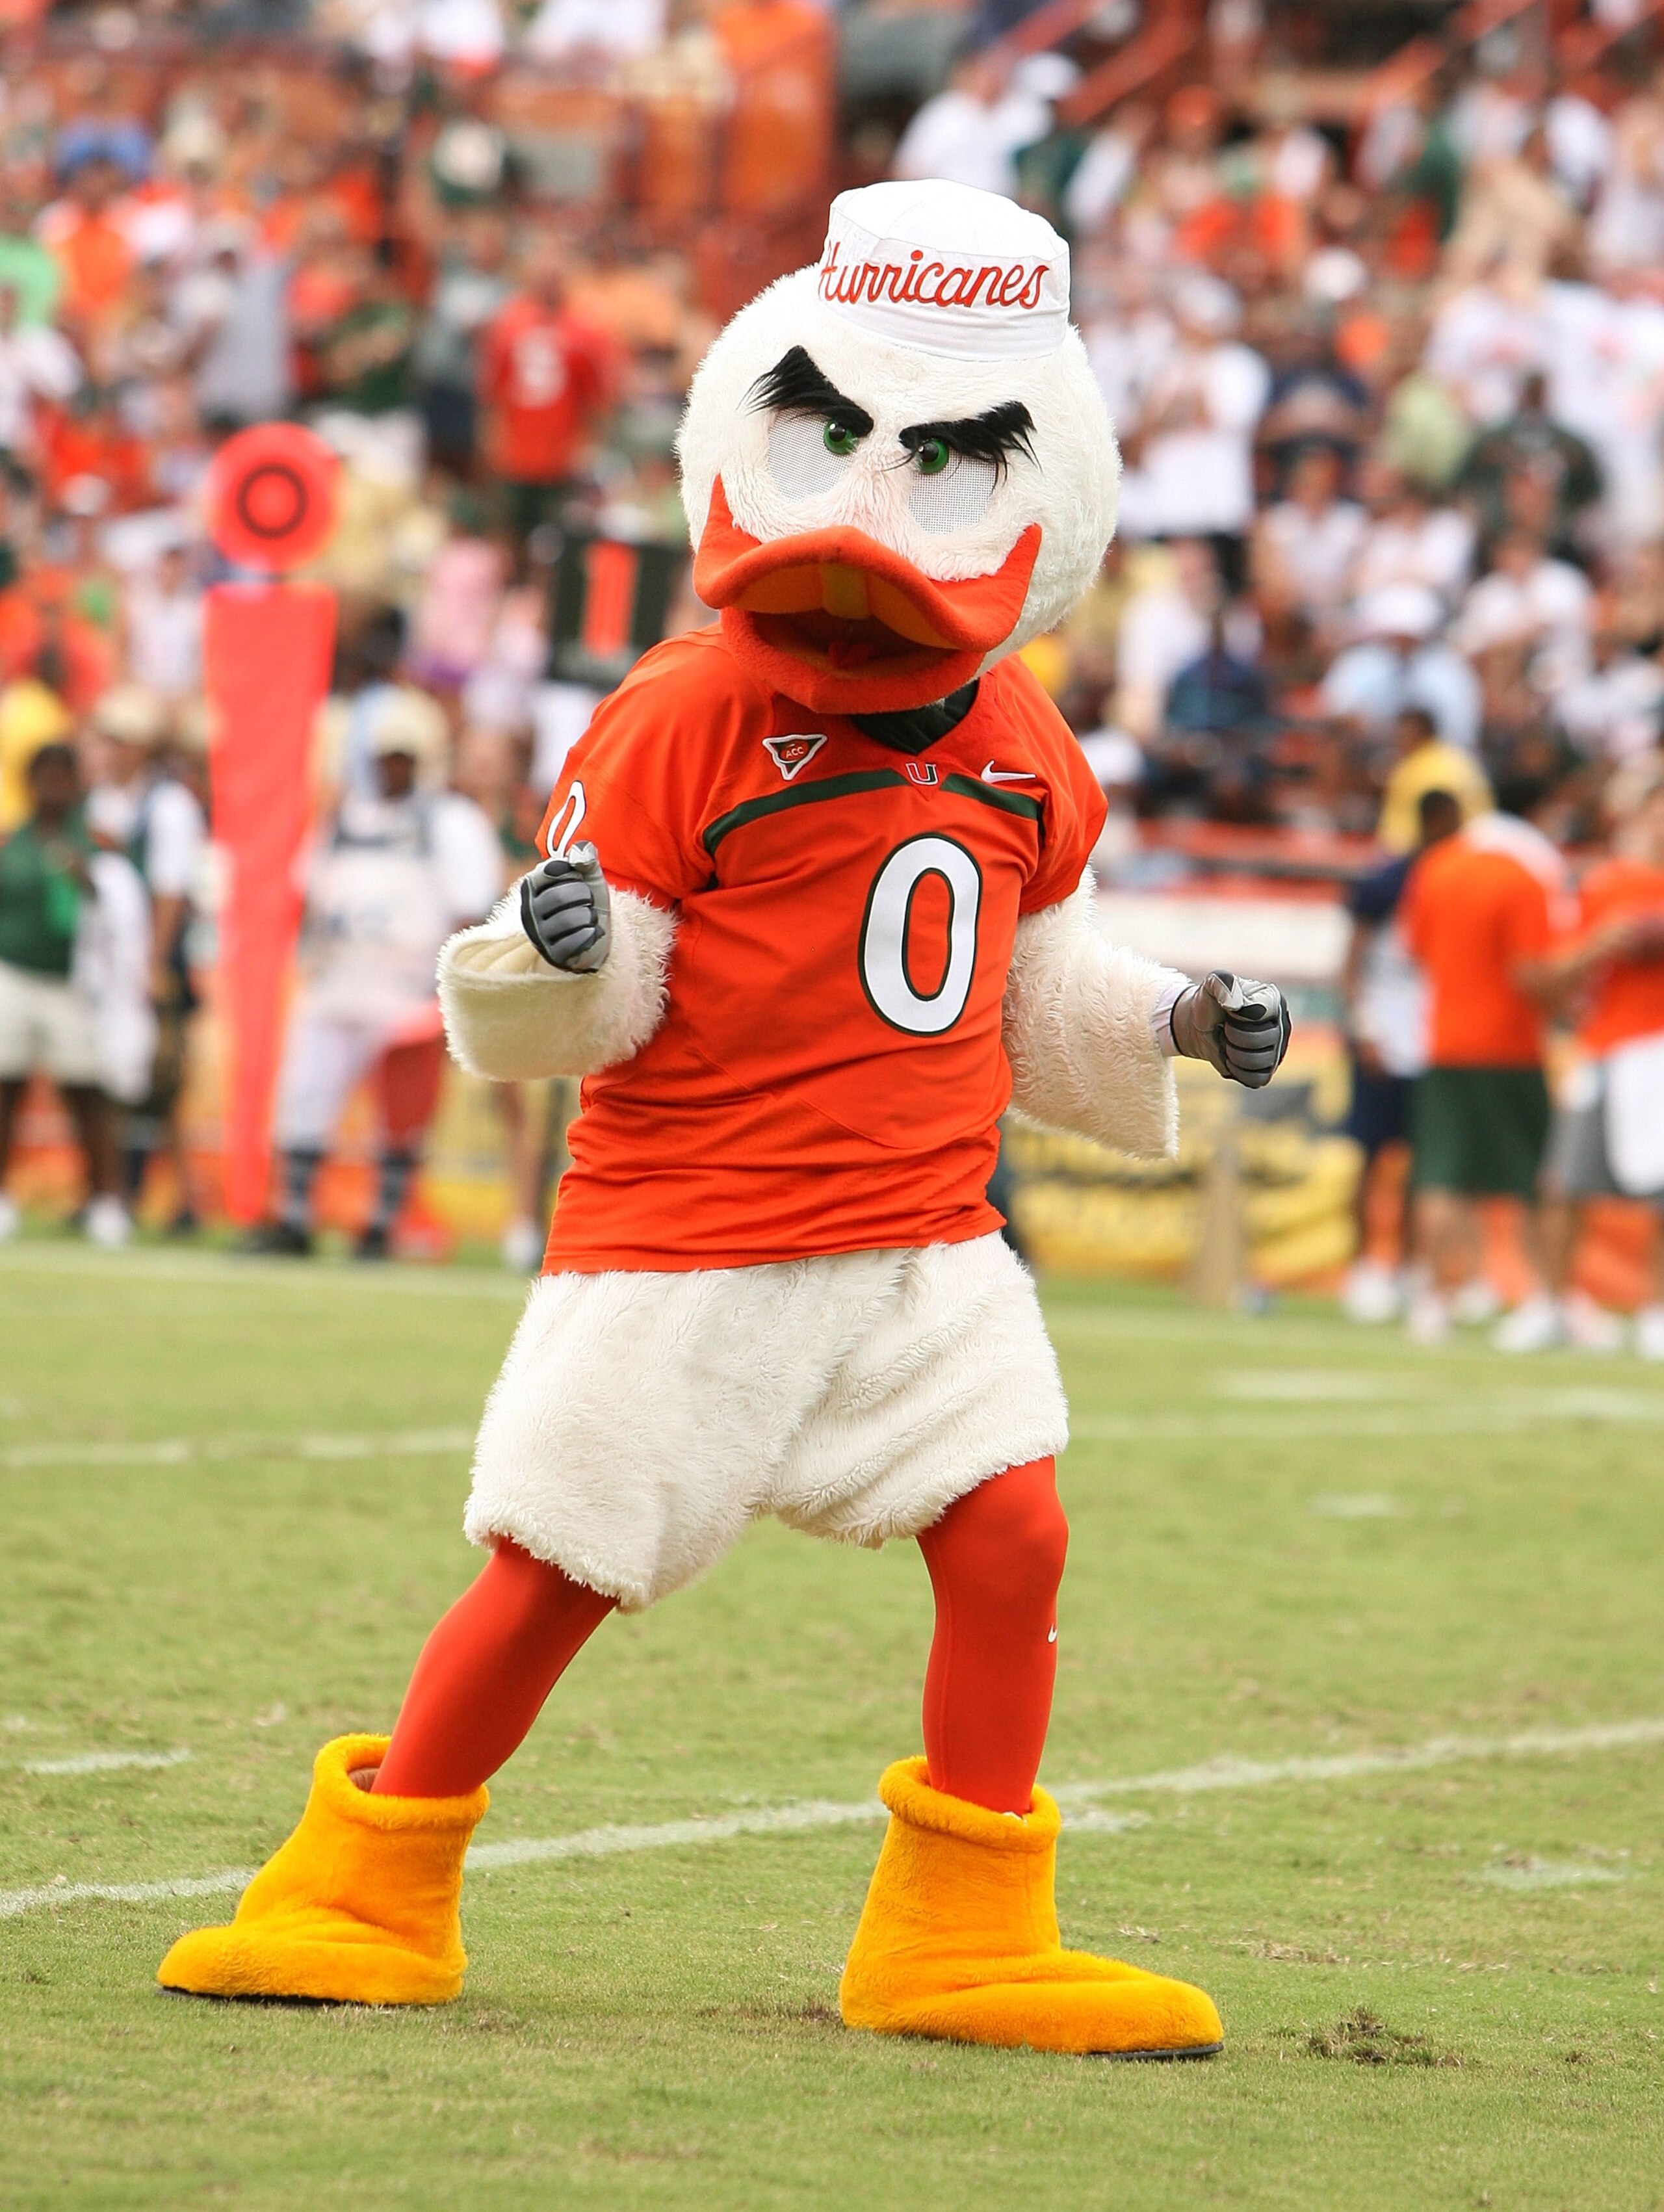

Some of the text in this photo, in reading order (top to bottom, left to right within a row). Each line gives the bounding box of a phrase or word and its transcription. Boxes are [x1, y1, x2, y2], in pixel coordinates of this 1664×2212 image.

[818, 241, 1050, 309] Hurricanes
[786, 746, 803, 758] ACC
[905, 762, 938, 785] U
[857, 832, 983, 1037] 0
